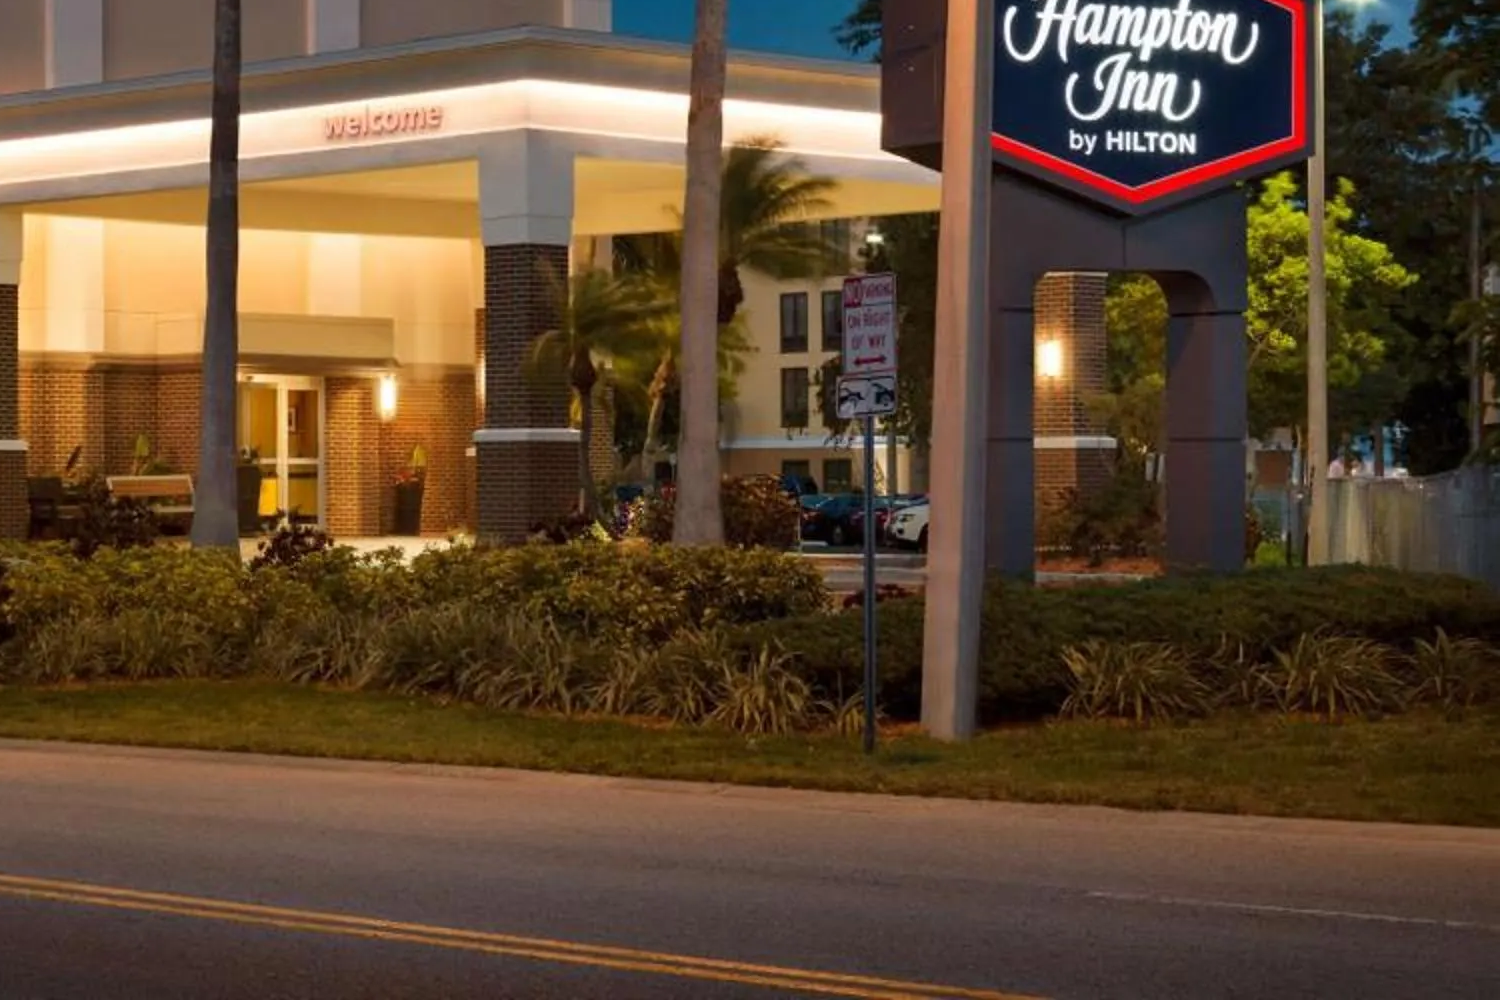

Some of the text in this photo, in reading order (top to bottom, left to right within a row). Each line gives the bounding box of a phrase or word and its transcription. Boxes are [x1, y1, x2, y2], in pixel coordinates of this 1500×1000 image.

[1065, 52, 1201, 121] Inn
[325, 104, 443, 140] welcome
[1068, 129, 1197, 155] by HILTON
